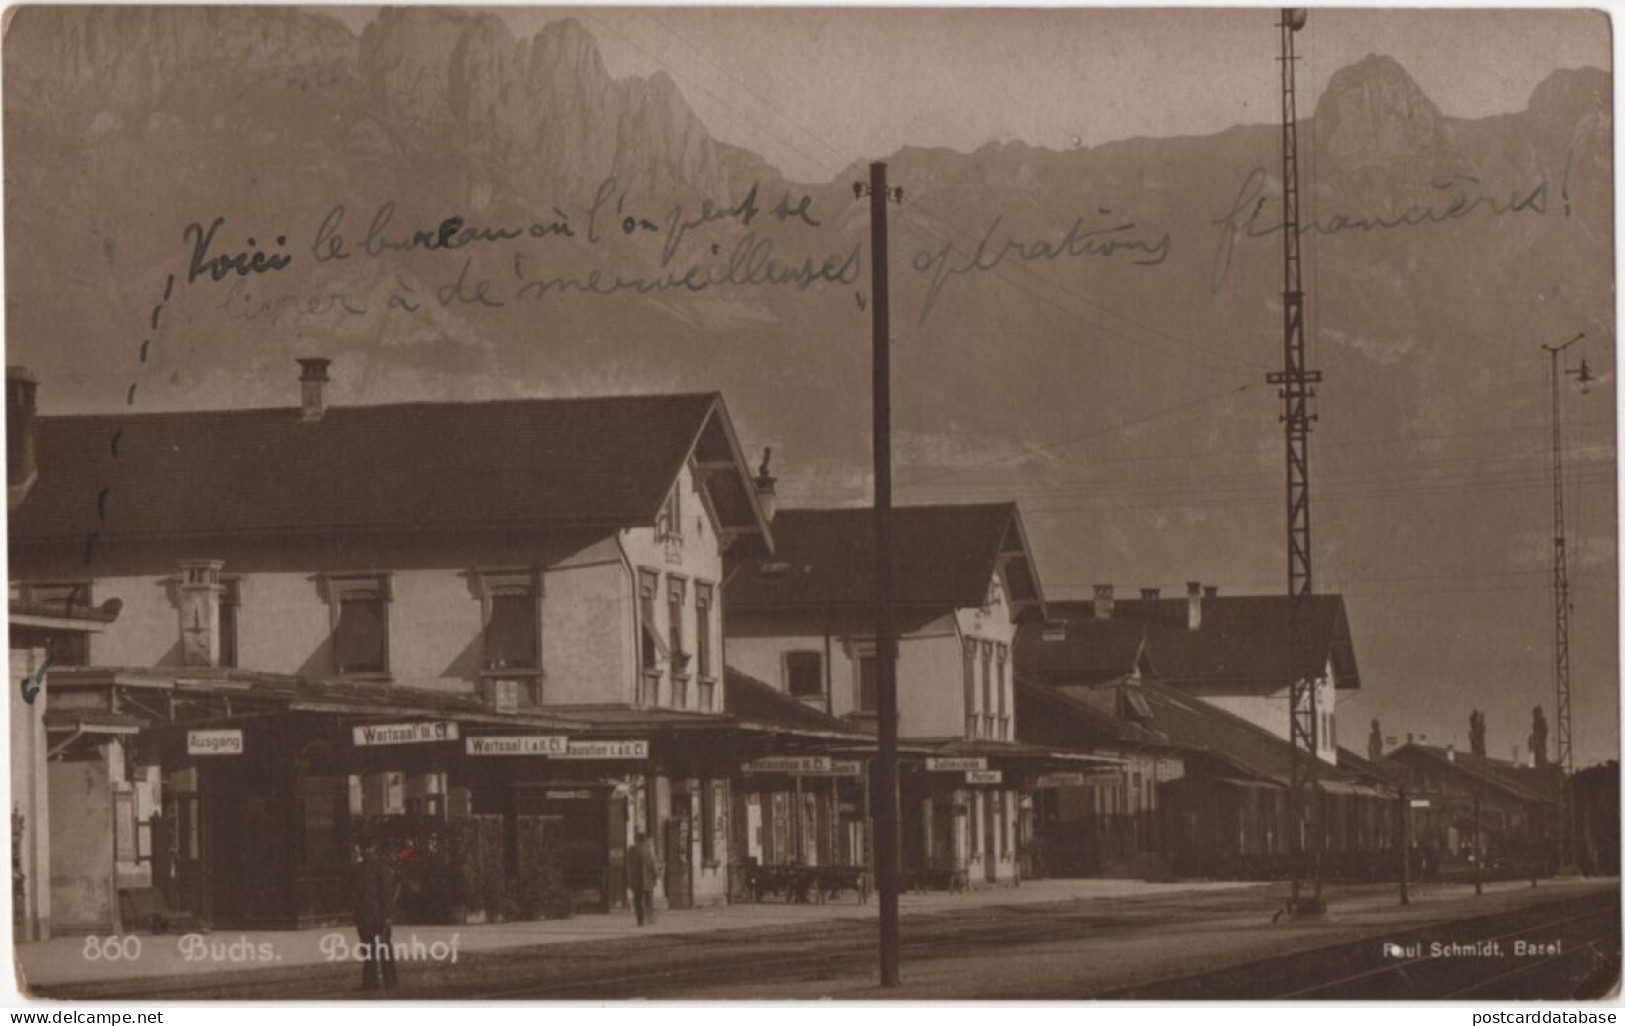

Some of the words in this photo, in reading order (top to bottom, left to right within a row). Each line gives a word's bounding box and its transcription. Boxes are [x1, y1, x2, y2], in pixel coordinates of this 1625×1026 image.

[184, 217, 291, 283] Voici
[311, 205, 350, 262] le
[357, 203, 521, 257] bureau
[660, 182, 759, 267] peut
[772, 196, 820, 227] se
[191, 734, 240, 750] Ausgang
[363, 725, 416, 743] Wartsaal
[473, 739, 521, 751] Wartsaal
